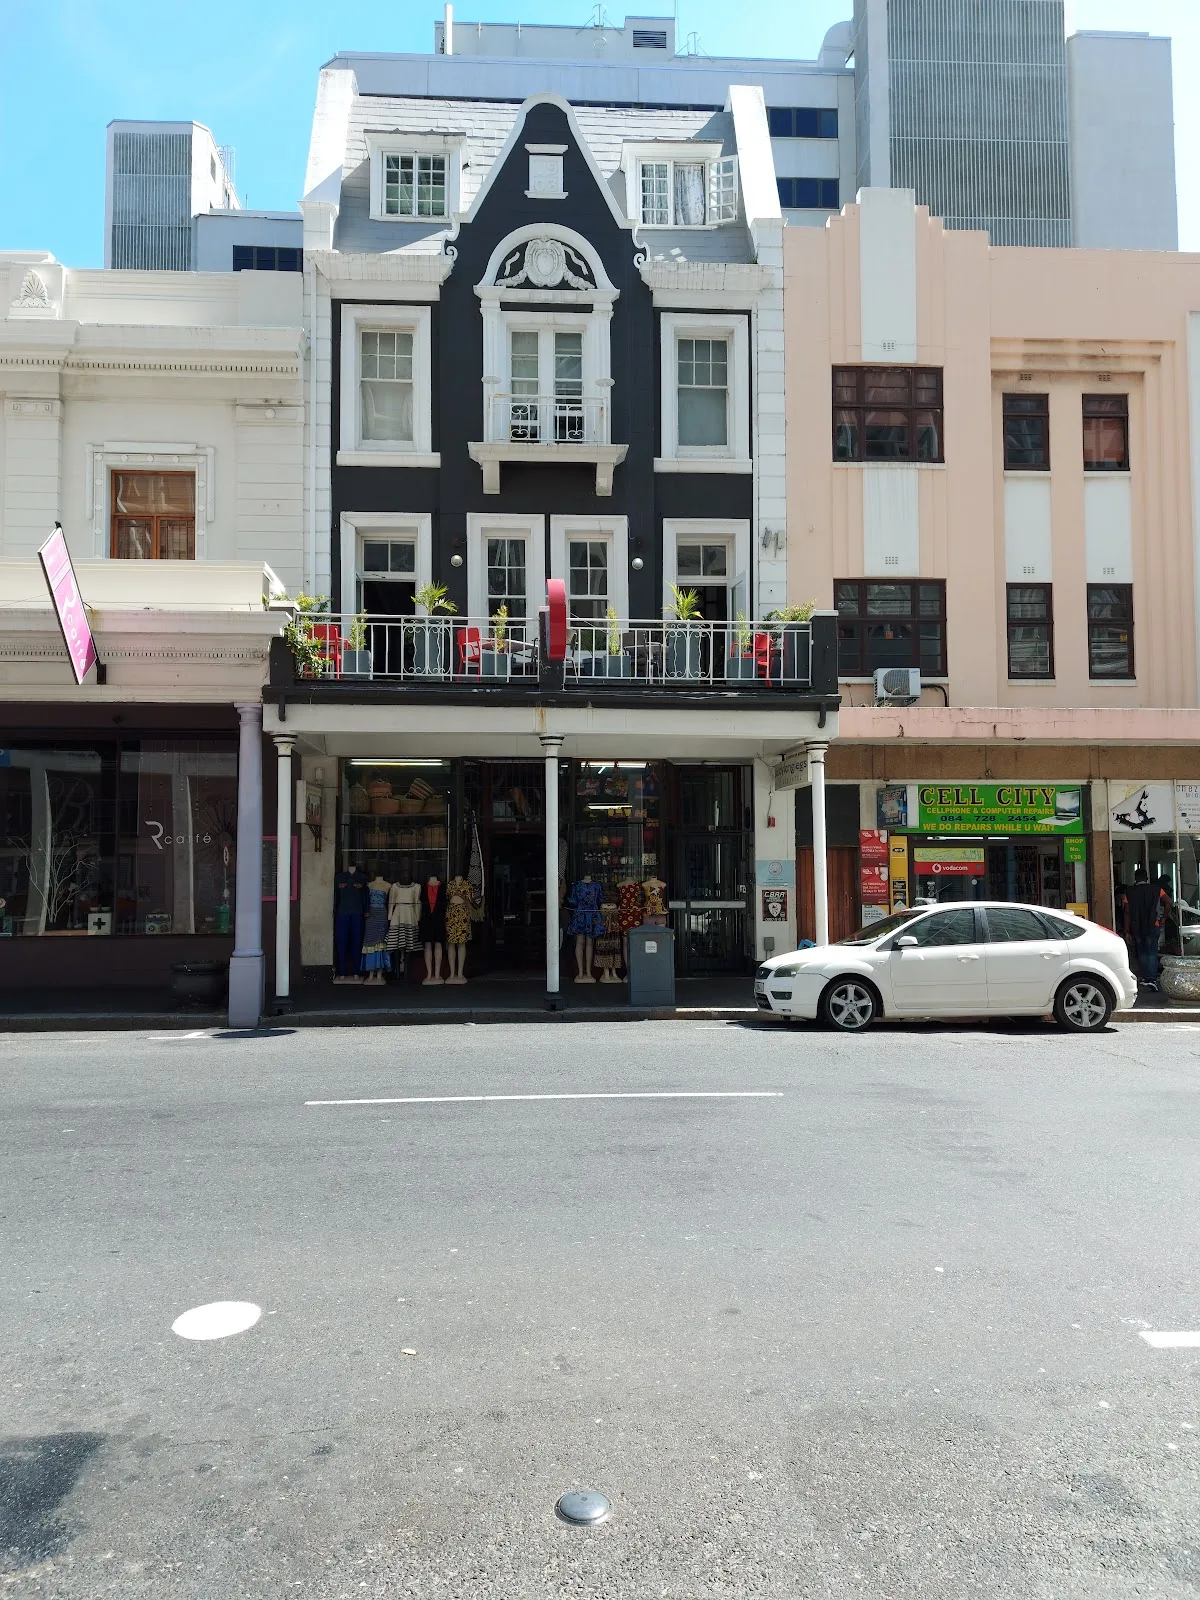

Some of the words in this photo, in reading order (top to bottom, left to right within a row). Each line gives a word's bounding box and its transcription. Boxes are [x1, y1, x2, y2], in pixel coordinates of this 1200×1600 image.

[919, 787, 985, 806] CELL
[996, 787, 1056, 806] CITY
[923, 823, 936, 831] WE
[939, 823, 951, 831] DO
[954, 823, 991, 831] REPAIRS
[994, 823, 1021, 831] WHILE
[1024, 823, 1030, 831] U
[1033, 823, 1055, 831] WAIT
